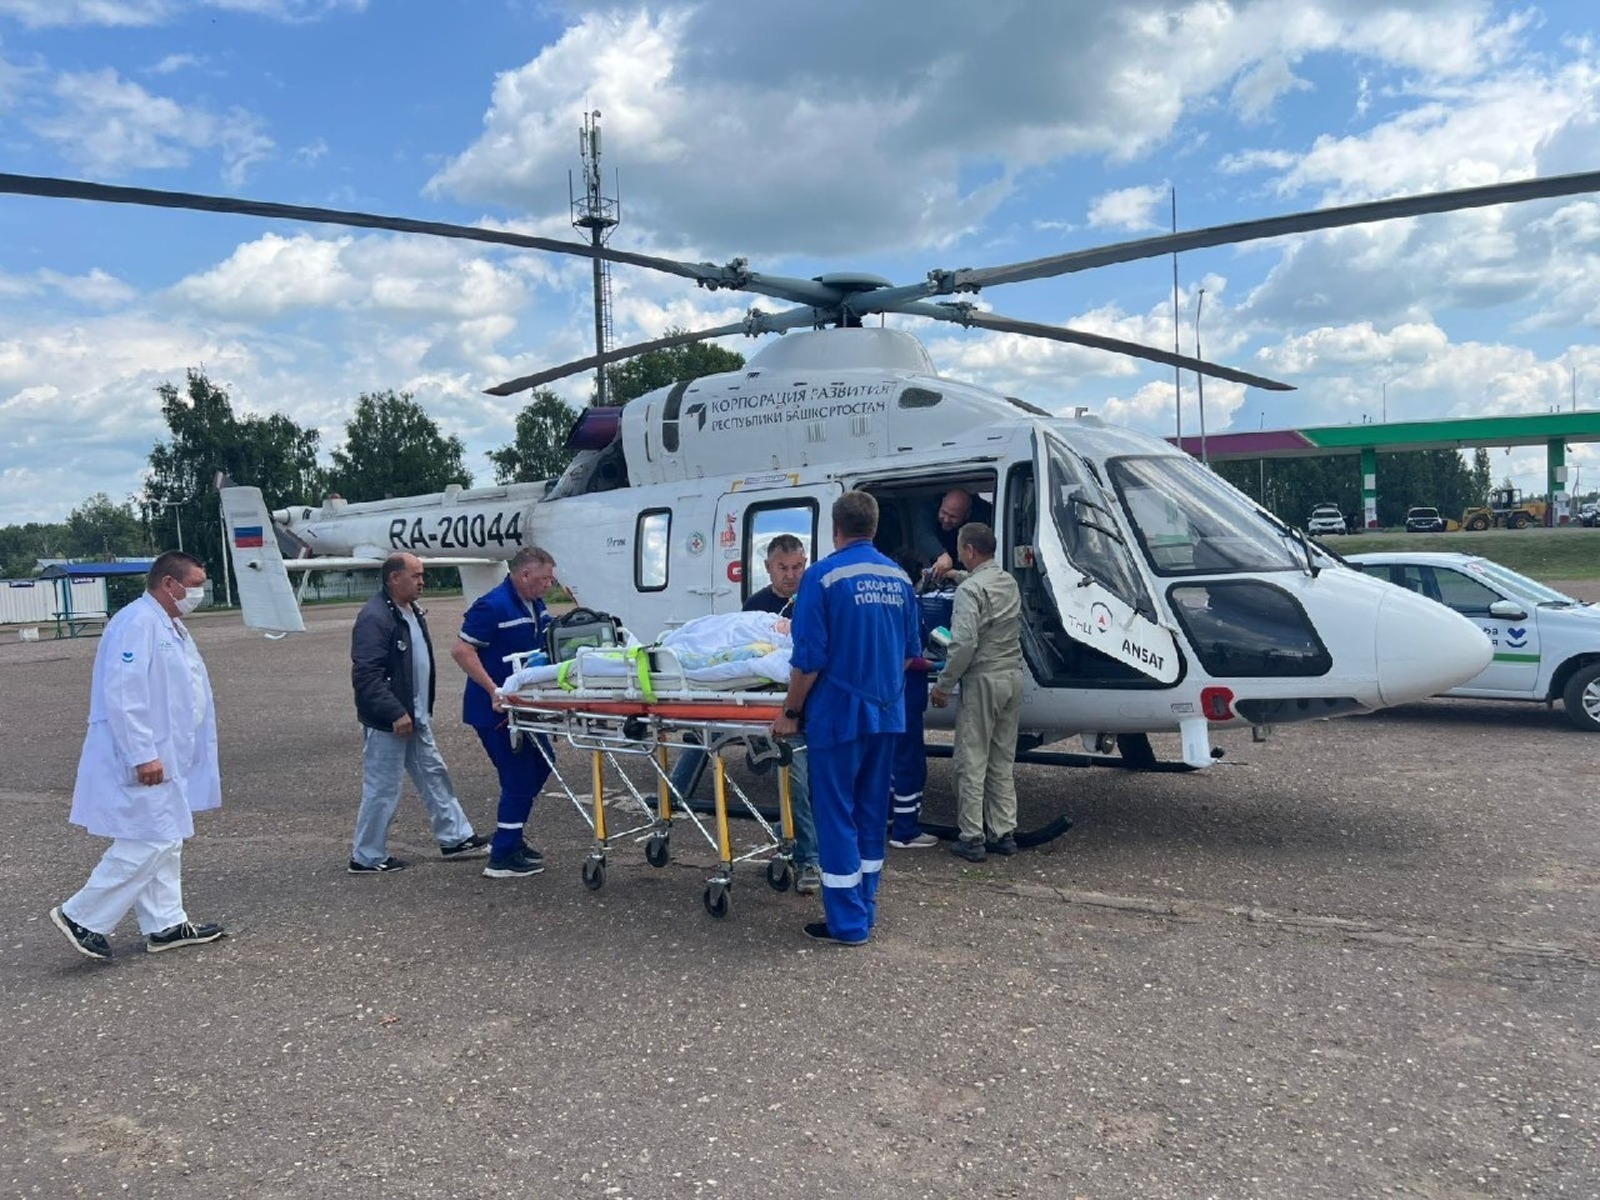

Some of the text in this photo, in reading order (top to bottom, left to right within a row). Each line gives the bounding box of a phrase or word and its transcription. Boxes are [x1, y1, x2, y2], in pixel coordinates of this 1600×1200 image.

[712, 389, 806, 414] КОРПОРАЦИЯ
[712, 402, 886, 432] РЕСПУБЛИКИ БАШКОРТОСТАН
[389, 511, 523, 550] RA-20044
[854, 592, 905, 608] ПОМОЩЬ
[856, 580, 902, 593] СКОРАЯ
[1122, 639, 1164, 671] ANSAT
